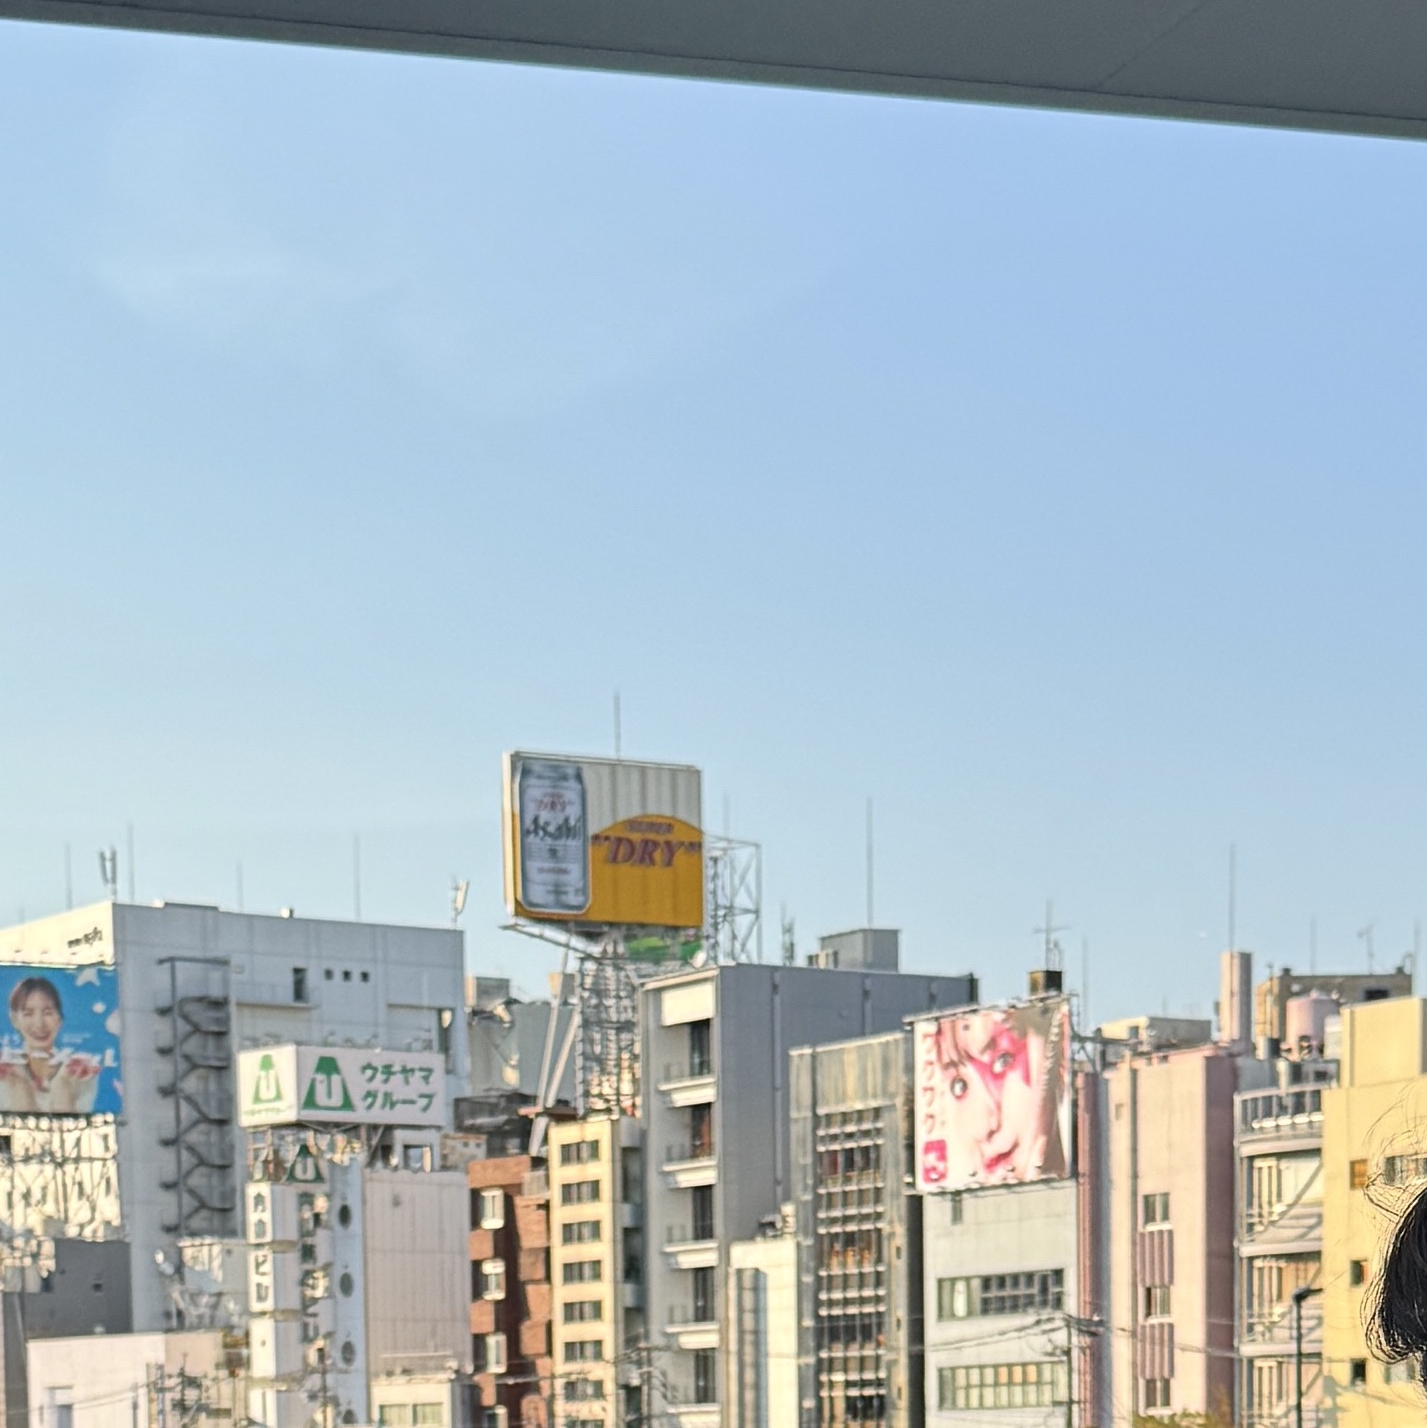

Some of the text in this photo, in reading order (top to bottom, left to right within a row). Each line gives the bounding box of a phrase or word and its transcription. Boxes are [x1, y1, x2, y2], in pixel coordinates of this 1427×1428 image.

[359, 1062, 435, 1087] ウチヤマ
[361, 1090, 437, 1114] グループ
